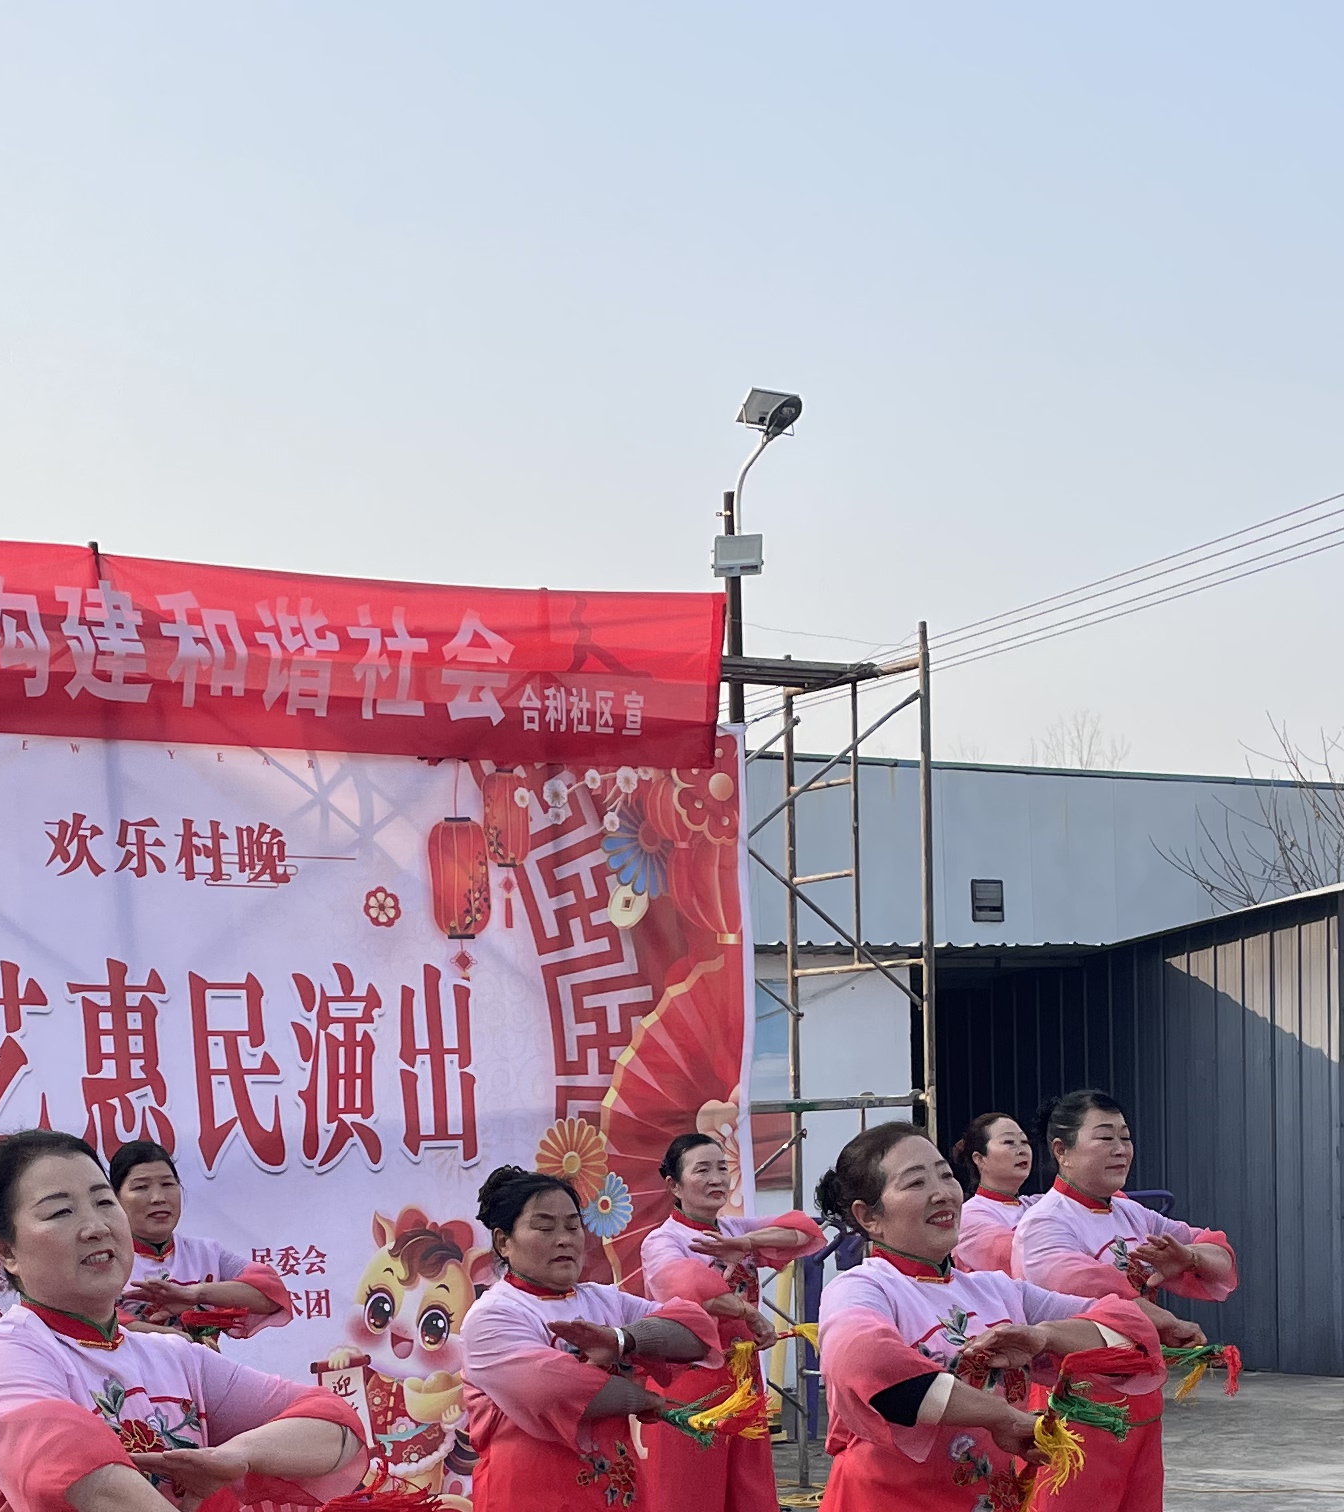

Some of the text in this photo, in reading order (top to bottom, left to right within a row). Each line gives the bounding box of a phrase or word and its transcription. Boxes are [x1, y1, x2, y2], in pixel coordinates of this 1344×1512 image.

[518, 683, 645, 736] 合利社区 宣
[43, 812, 293, 884] 欢乐村晚
